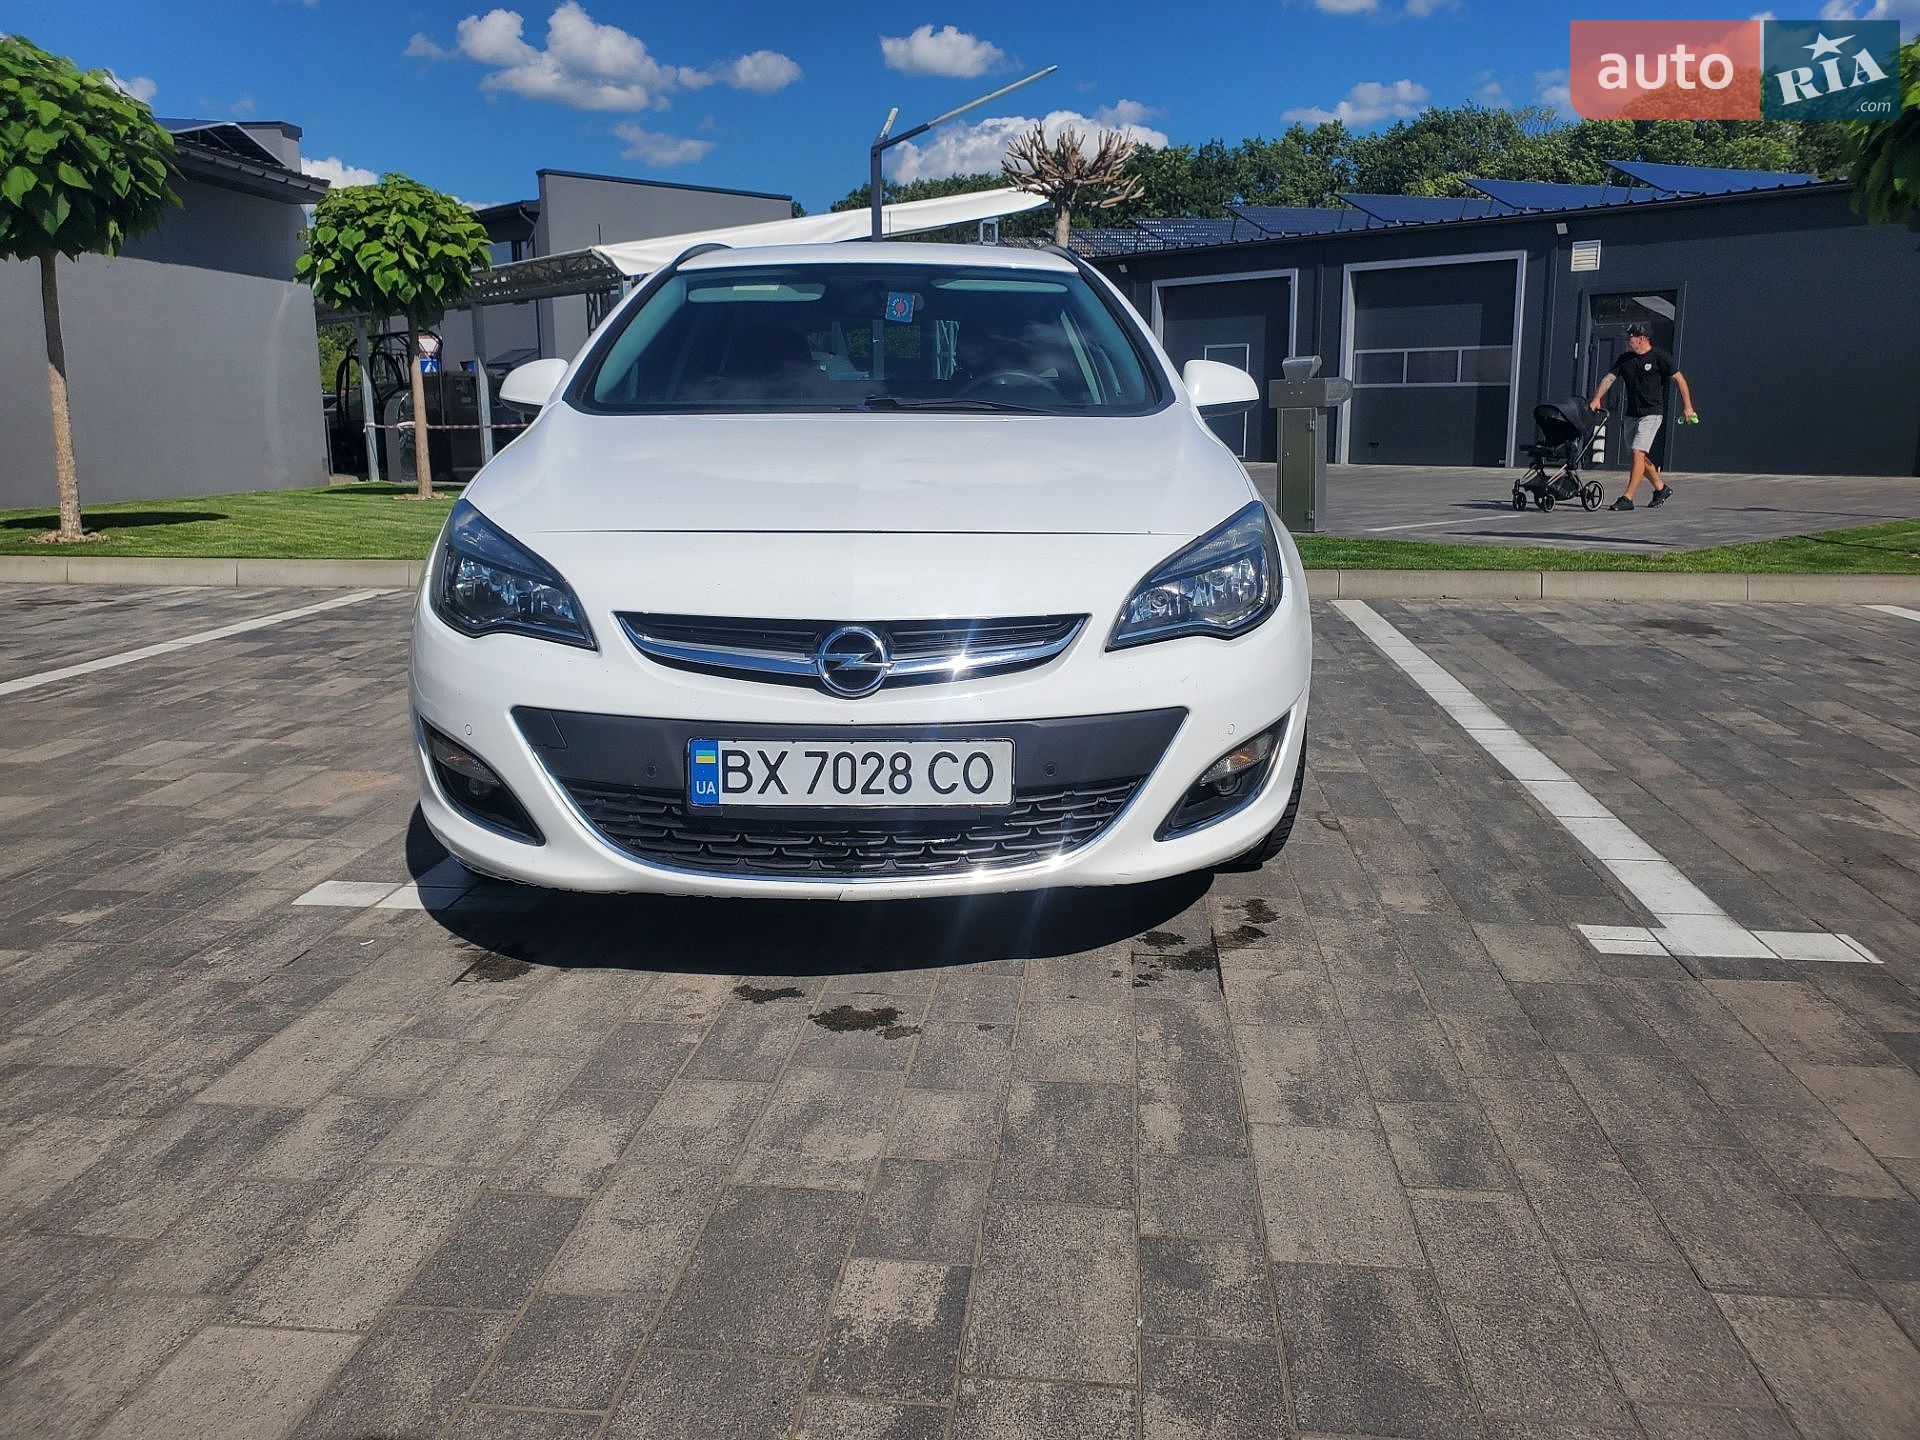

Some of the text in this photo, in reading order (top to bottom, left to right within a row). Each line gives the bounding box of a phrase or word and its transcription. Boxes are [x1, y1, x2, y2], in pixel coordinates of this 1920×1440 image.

[721, 749, 994, 795] BX 7028 CO
[696, 780, 716, 795] UA
